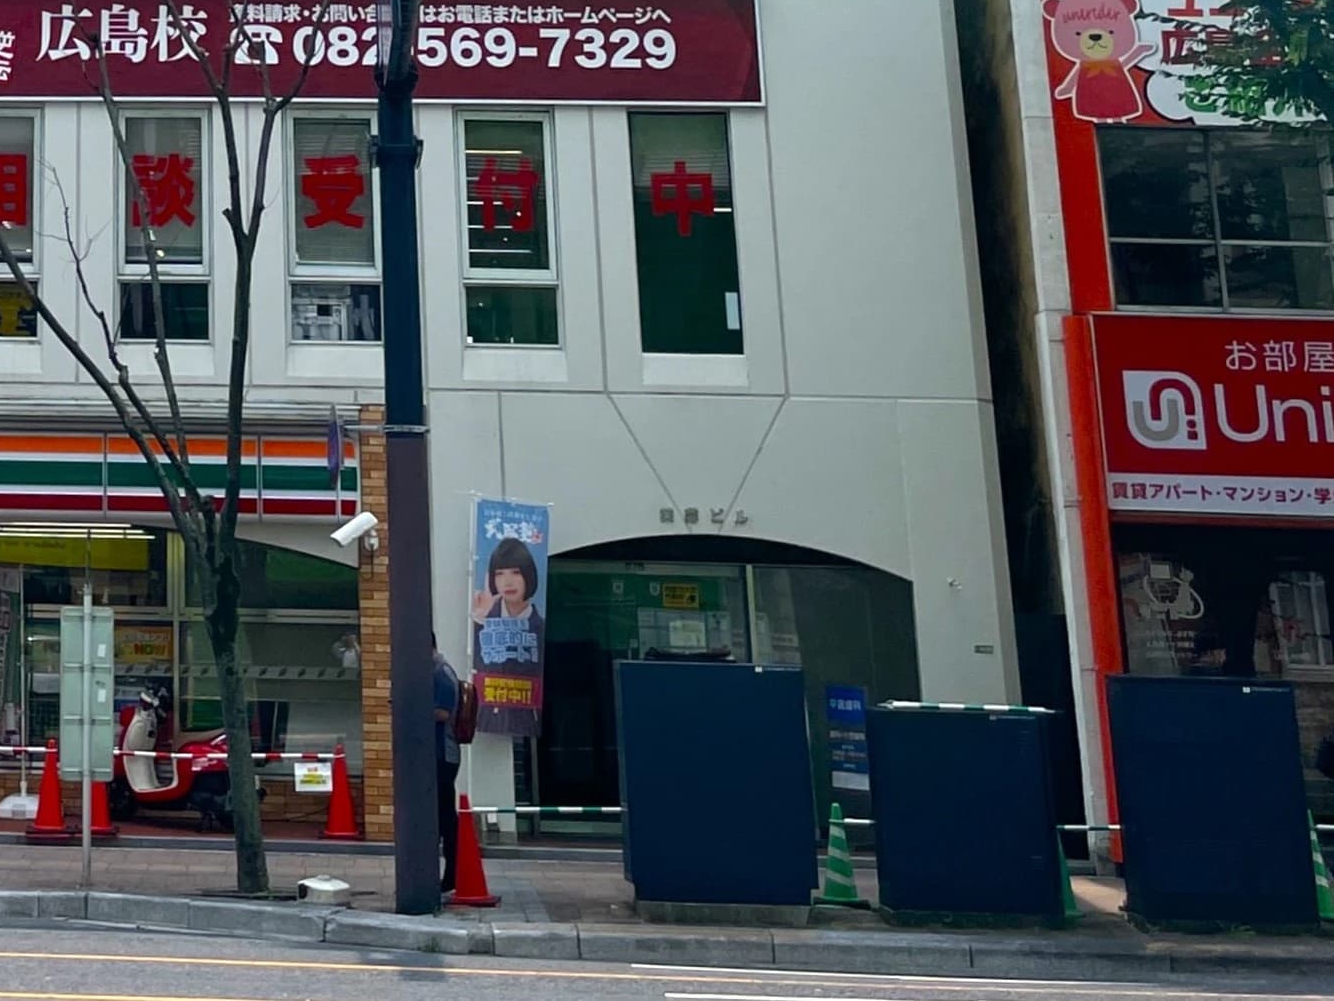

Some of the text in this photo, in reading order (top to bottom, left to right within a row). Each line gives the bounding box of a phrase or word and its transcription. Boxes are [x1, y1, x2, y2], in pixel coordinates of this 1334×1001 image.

[35, 3, 210, 63] 広島校
[1111, 480, 1334, 506] 賃貸アパート・マンション・学
